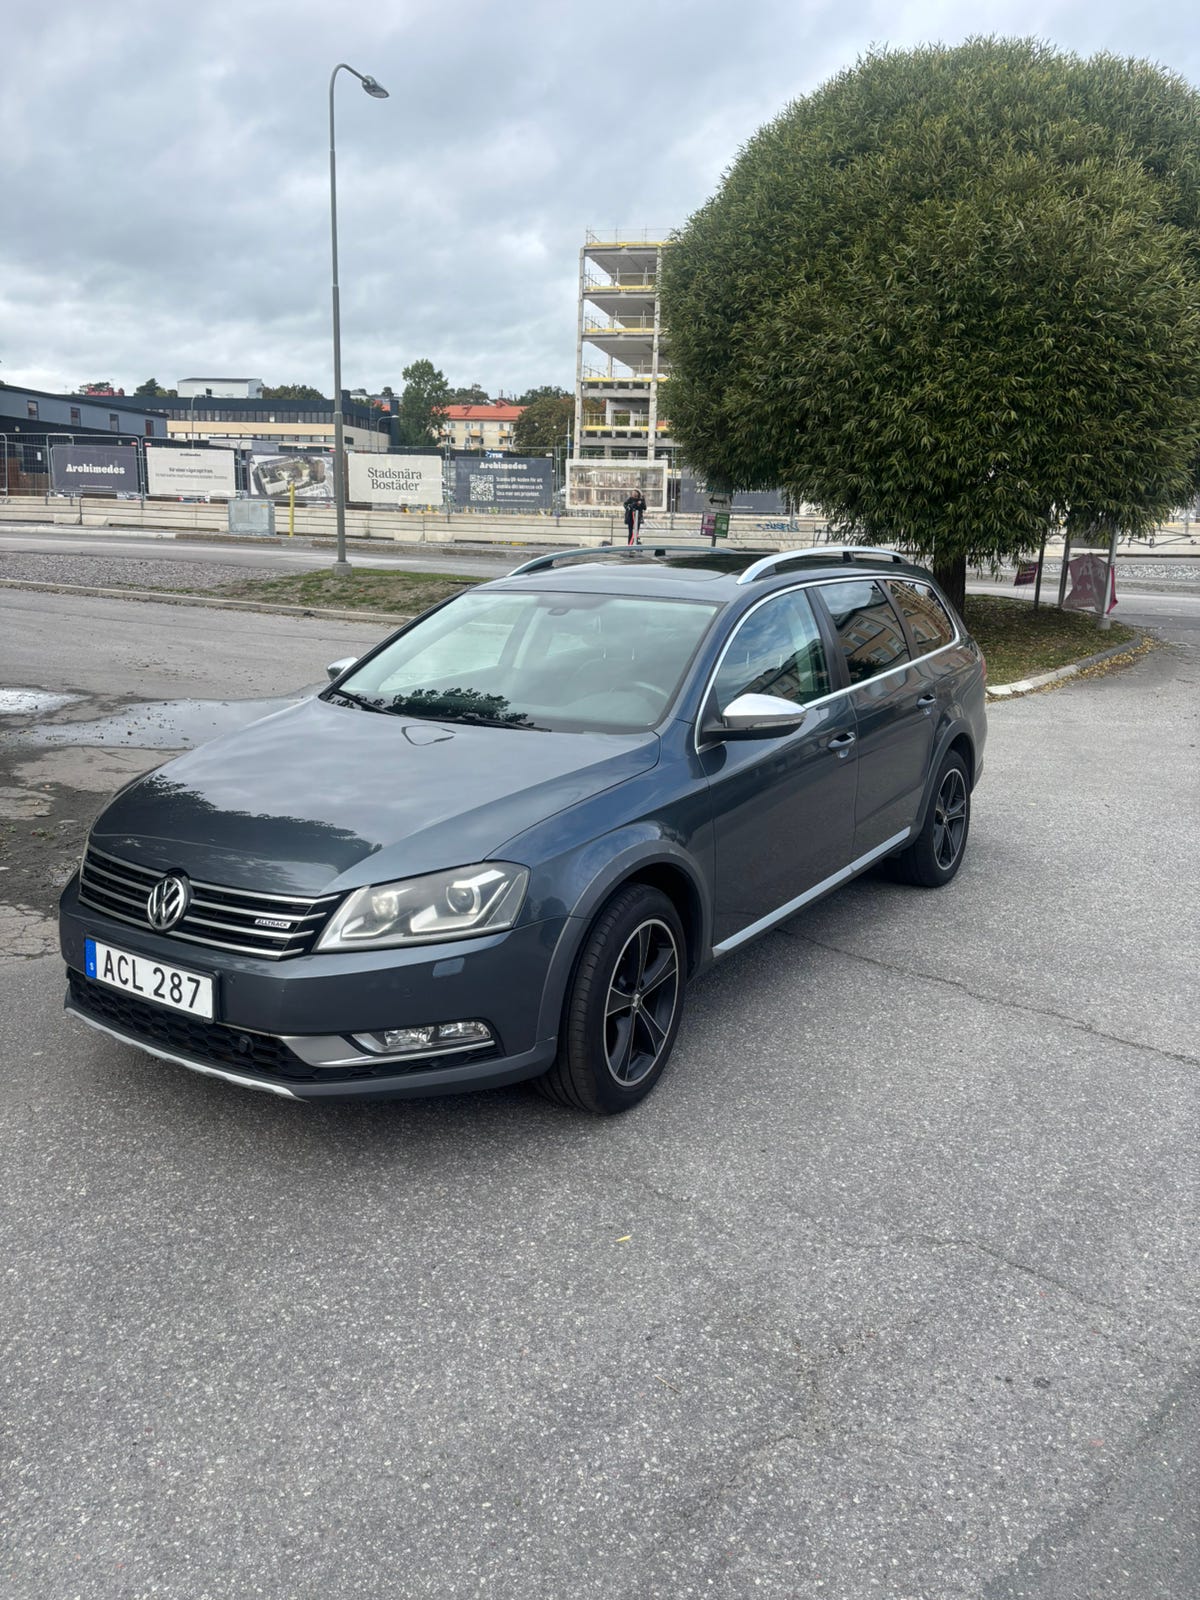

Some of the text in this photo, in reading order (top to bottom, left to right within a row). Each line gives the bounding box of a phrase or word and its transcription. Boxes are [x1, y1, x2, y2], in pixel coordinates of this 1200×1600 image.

[66, 464, 126, 474] Archimedes
[480, 462, 528, 470] Archimedes
[368, 467, 422, 480] Stadsnära
[371, 478, 420, 490] Bostäder
[103, 949, 201, 1009] ACL 287
